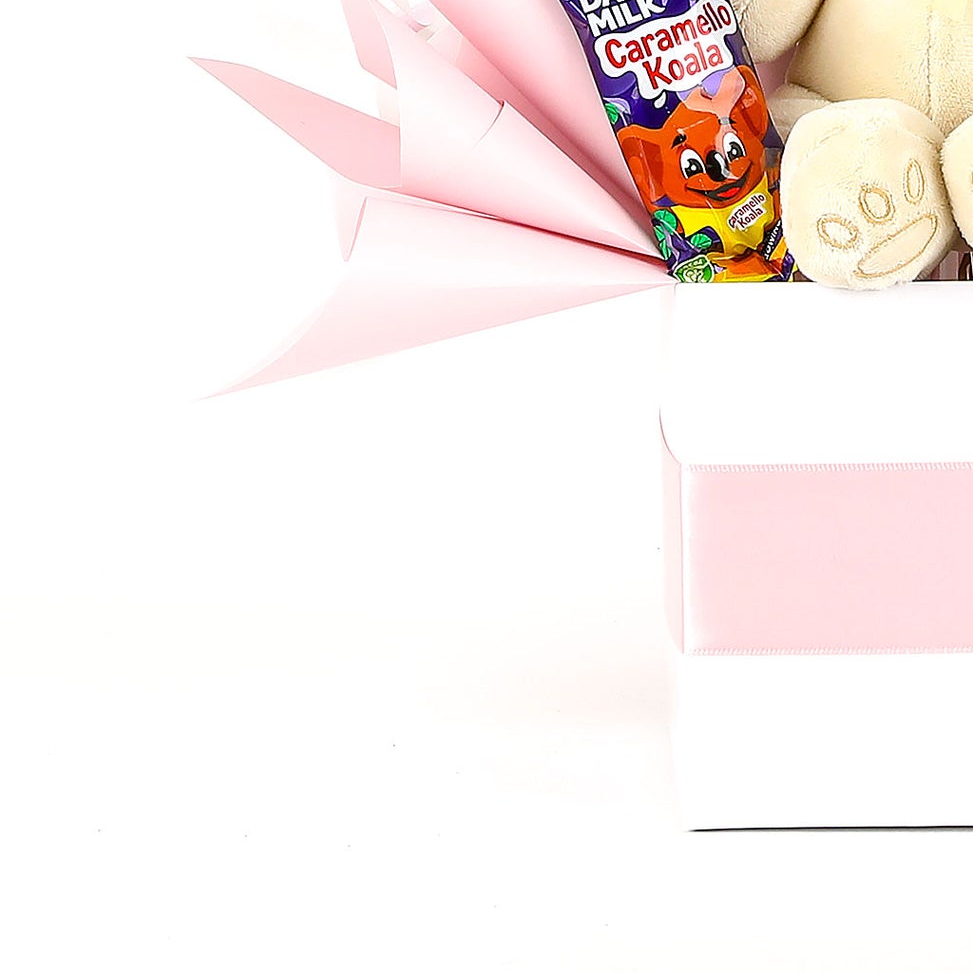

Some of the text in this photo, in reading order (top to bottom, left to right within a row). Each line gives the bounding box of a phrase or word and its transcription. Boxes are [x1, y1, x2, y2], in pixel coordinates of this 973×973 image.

[604, 2, 732, 69] Caramello
[642, 42, 724, 91] Koala
[737, 208, 764, 229] Koala
